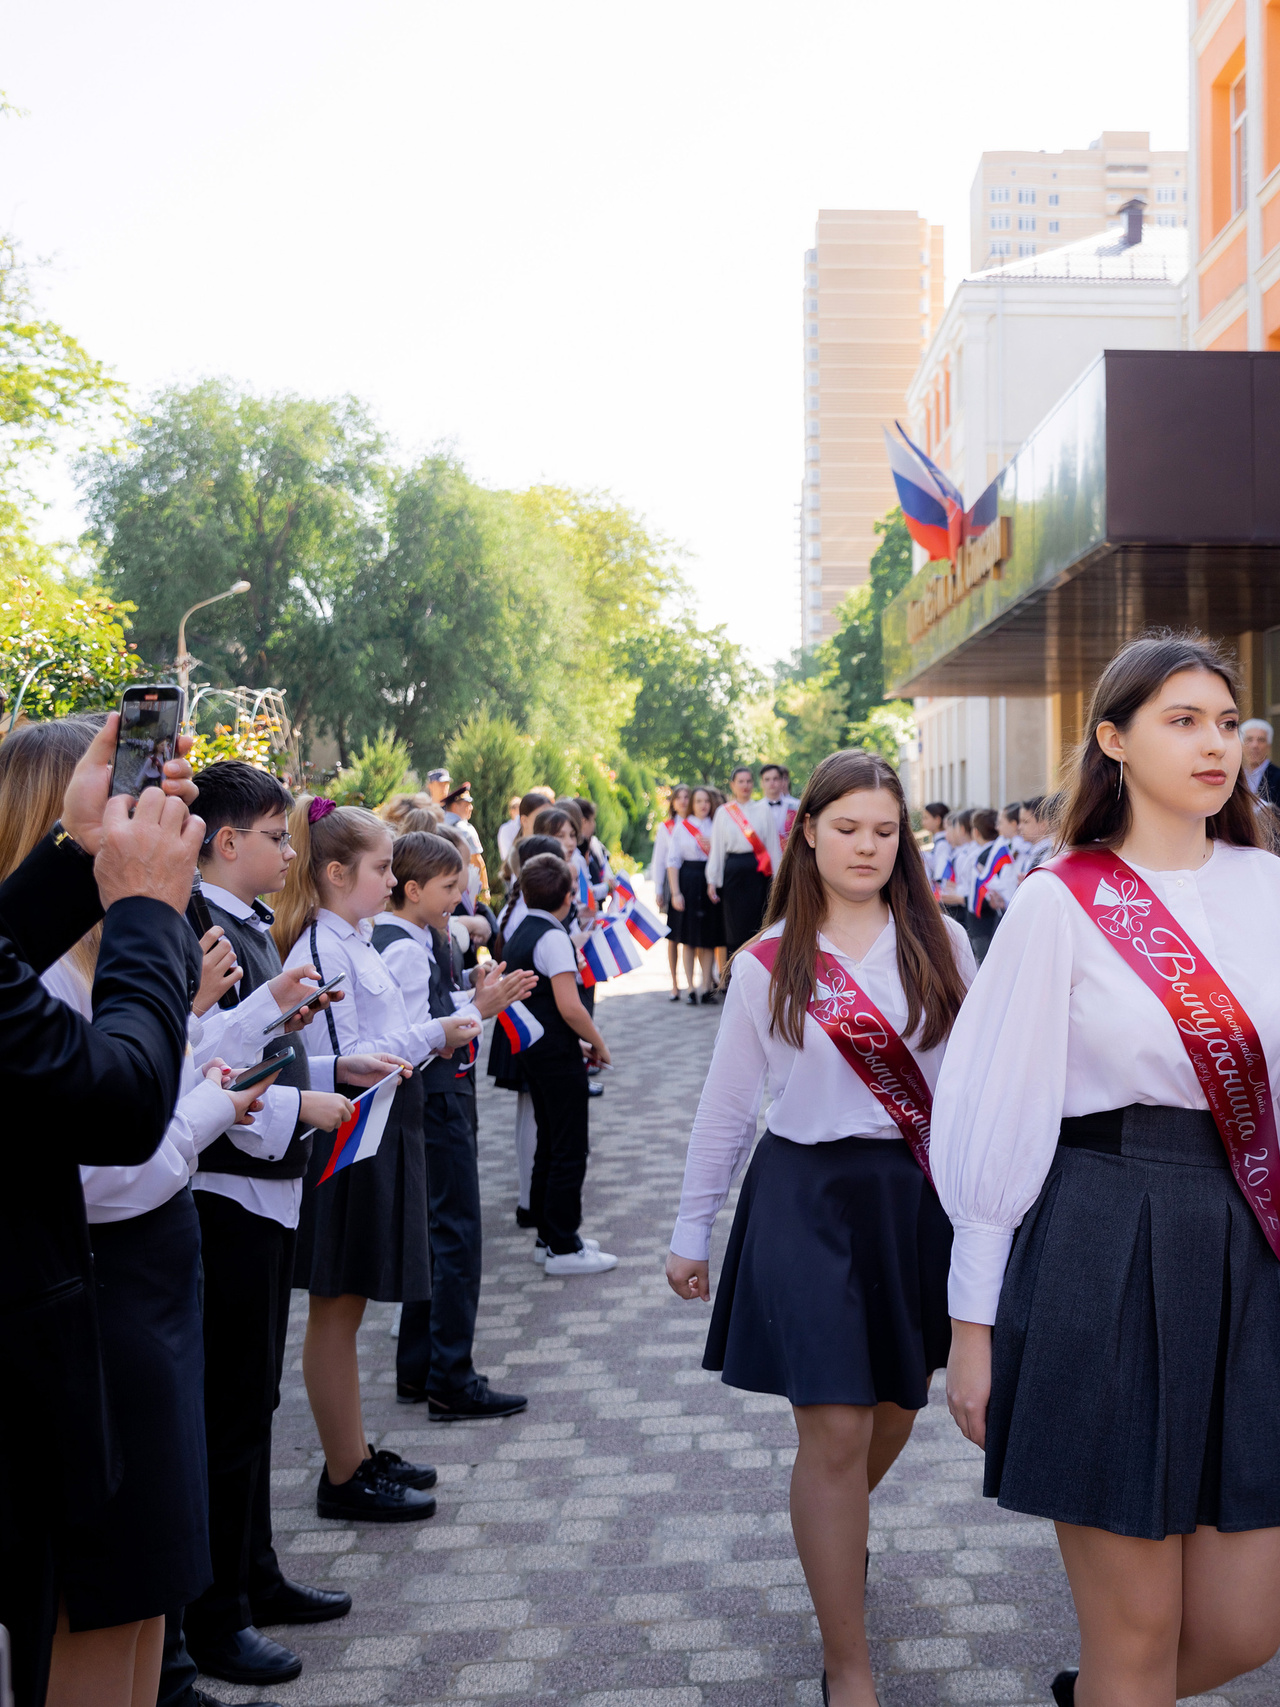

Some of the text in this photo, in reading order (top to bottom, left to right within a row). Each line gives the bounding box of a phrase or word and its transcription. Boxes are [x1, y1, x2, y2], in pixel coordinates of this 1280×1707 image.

[1132, 927, 1256, 1141] Выпускница
[1209, 991, 1267, 1115] Пастухова Майя
